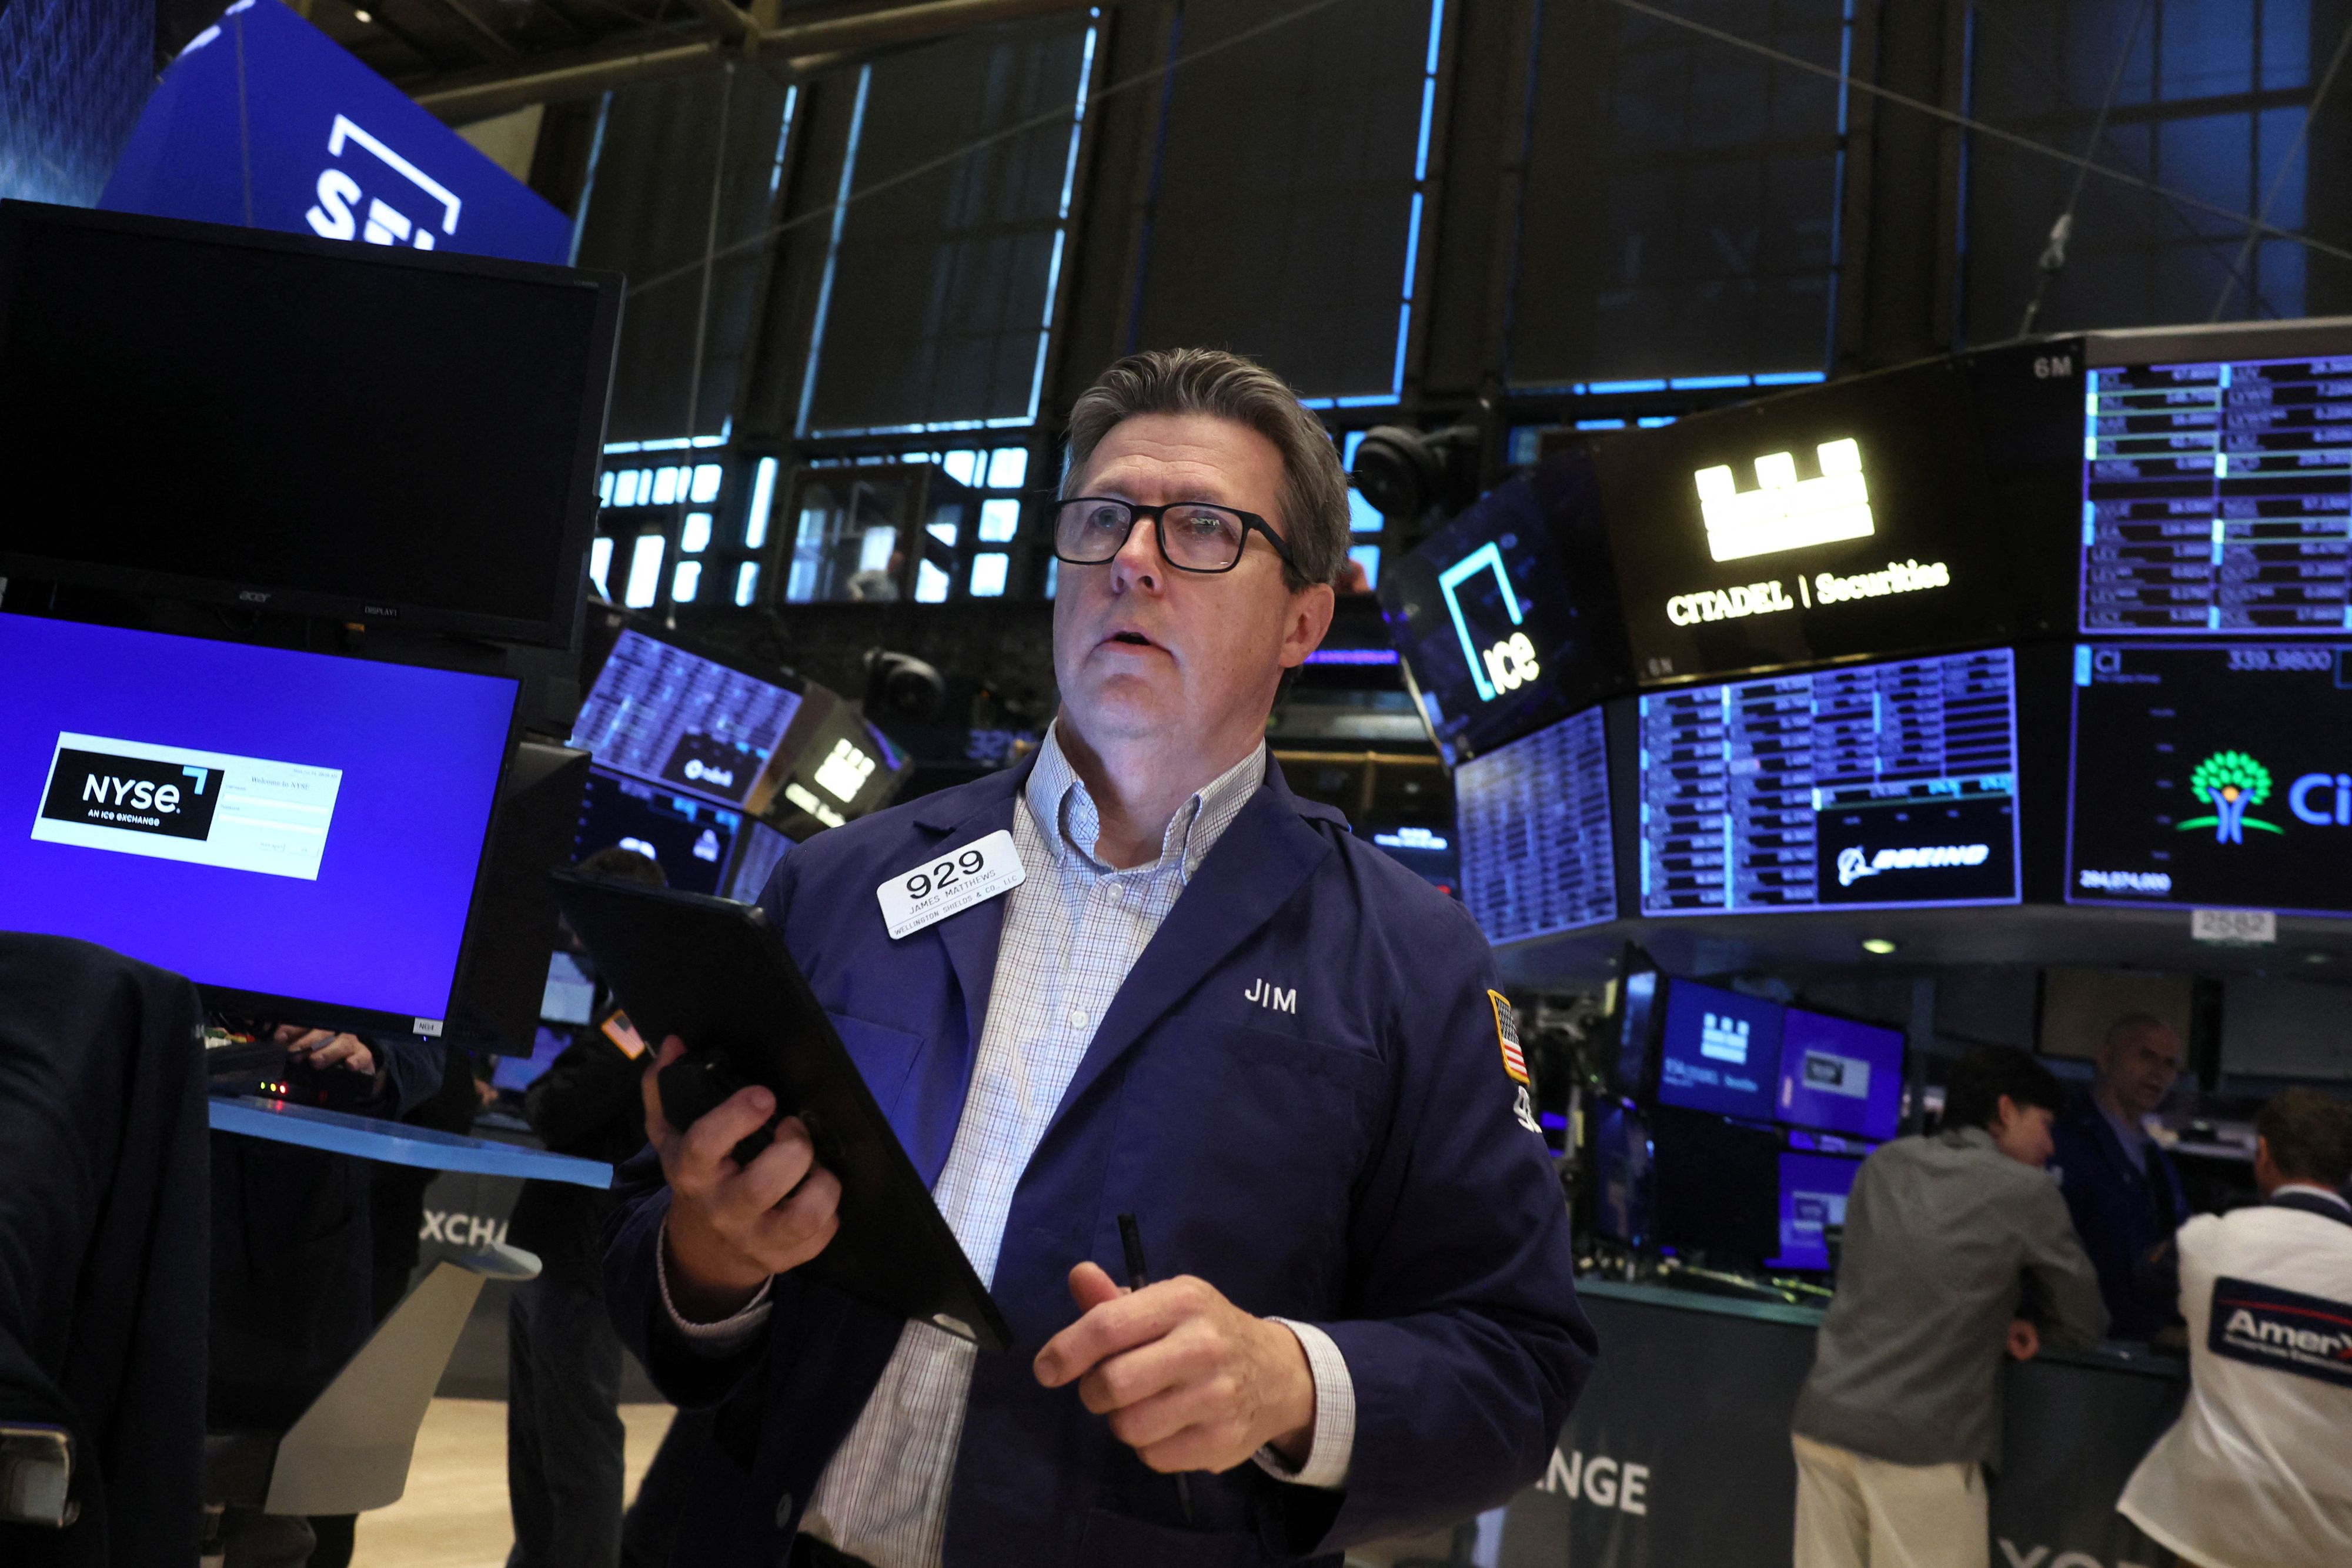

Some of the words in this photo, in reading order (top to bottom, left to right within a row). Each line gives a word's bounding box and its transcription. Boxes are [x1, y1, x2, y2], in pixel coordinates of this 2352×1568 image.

[2034, 356, 2072, 378] 6M
[1667, 580, 1793, 626] CITADEL
[1816, 559, 1950, 604] Securities
[252, 775, 280, 786] Welcome
[88, 809, 100, 819] AN
[906, 850, 984, 900] 929
[909, 895, 940, 915] JAMES
[945, 870, 996, 897] MATTHEWS
[894, 911, 939, 935] WELLINGTON
[943, 896, 973, 913] SHIELDS
[1003, 875, 1018, 885] LLC
[1245, 978, 1296, 1014] JIM
[1535, 1446, 1650, 1516] NGE
